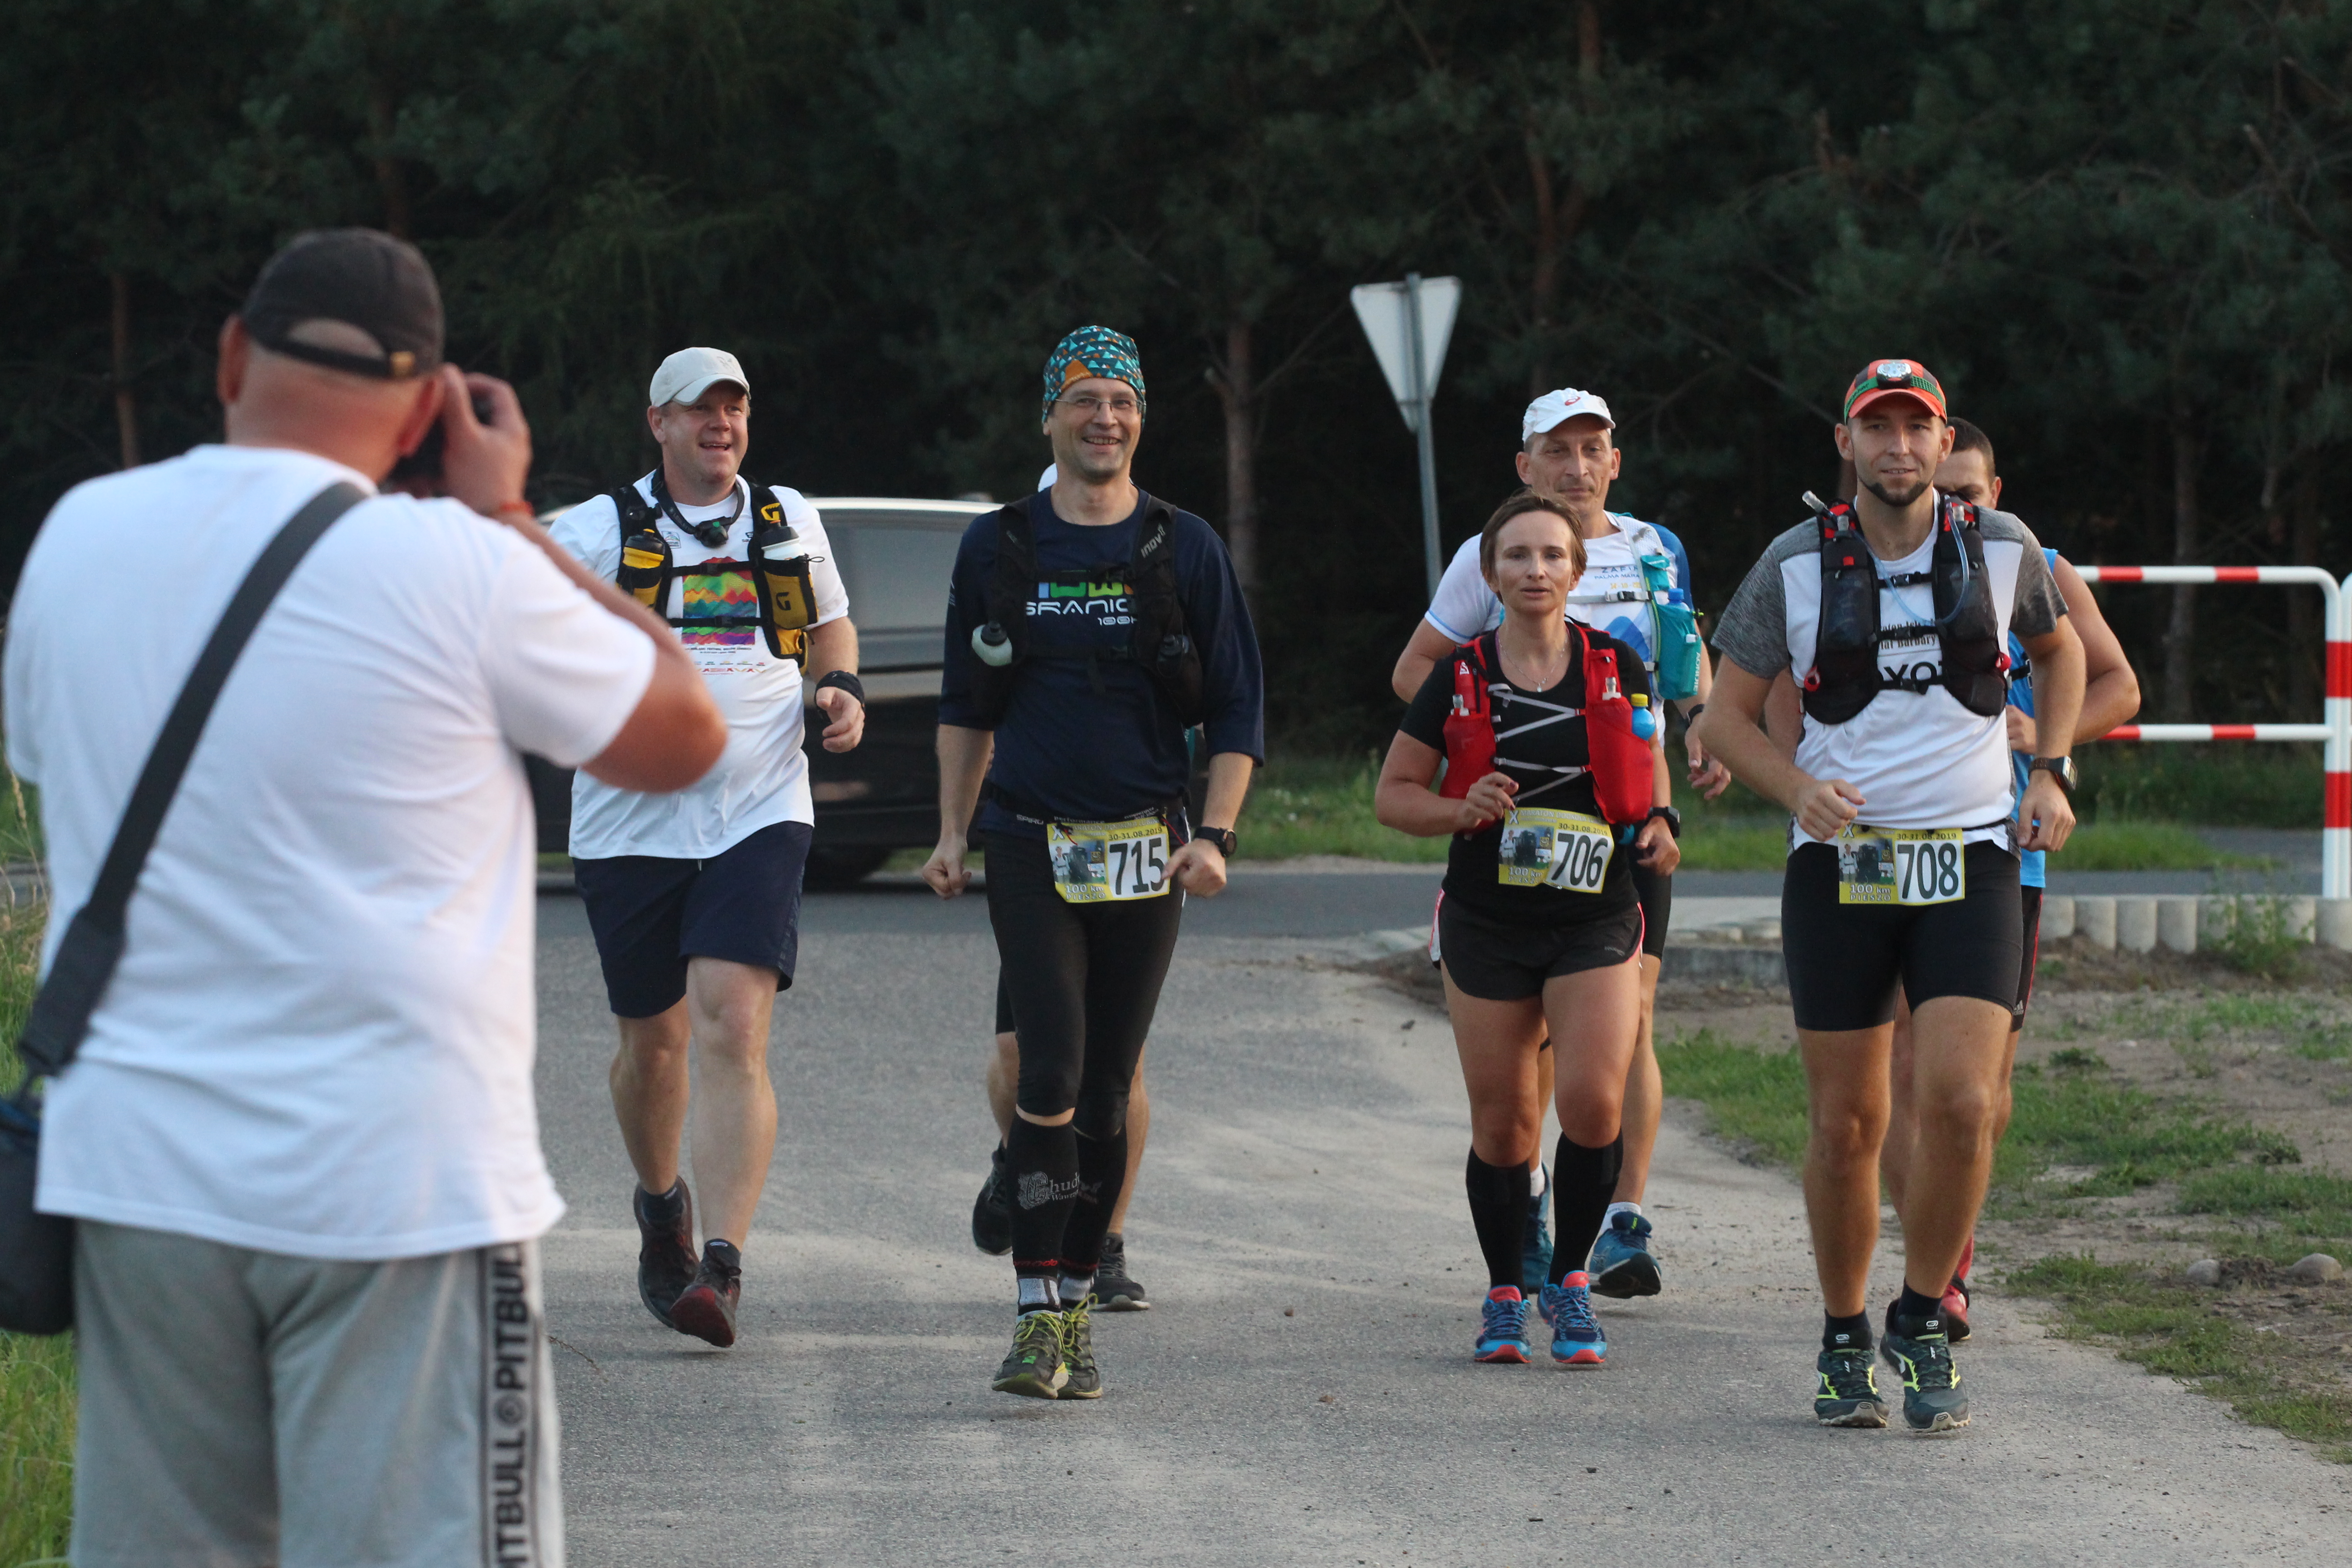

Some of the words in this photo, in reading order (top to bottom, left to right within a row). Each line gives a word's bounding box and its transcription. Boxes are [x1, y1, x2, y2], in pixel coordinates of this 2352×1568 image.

[1509, 810, 1519, 824] X
[1108, 827, 1162, 841] 30-31.08.2019
[1558, 823, 1608, 835] 30-31.08.2019
[1842, 823, 1855, 838] X
[1109, 837, 1166, 895] 715
[1551, 833, 1608, 887] 706
[1509, 867, 1529, 876] 100
[1897, 842, 1959, 899] 708
[1065, 884, 1088, 893] 100
[1850, 884, 1873, 893] 100
